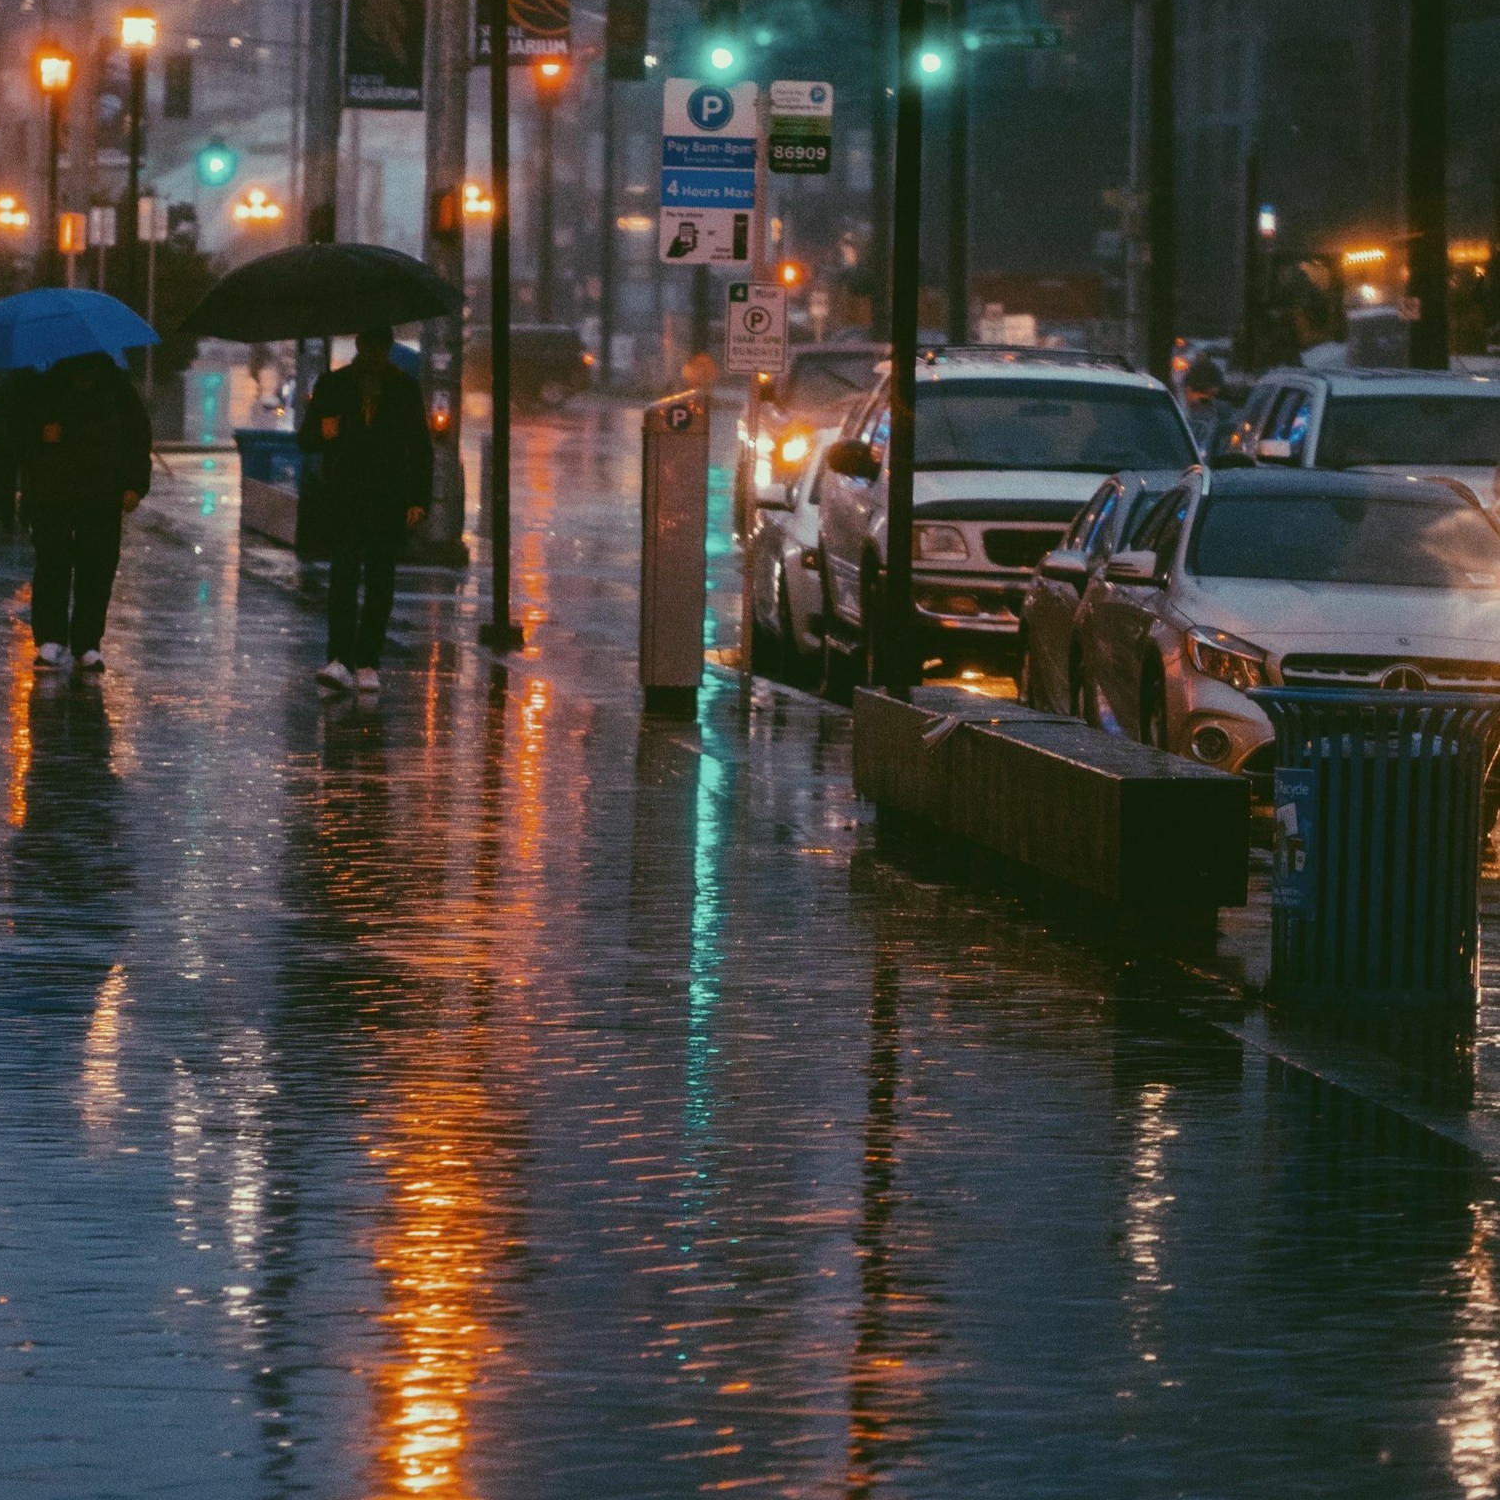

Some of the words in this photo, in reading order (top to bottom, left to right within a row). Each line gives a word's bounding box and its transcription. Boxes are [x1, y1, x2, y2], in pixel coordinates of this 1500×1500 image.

[479, 38, 569, 55] AARIUM
[702, 95, 724, 122] P
[667, 140, 689, 155] Pay
[773, 145, 827, 161] 86909
[666, 179, 680, 197] 4
[681, 186, 721, 198] Hours
[672, 409, 688, 427] P
